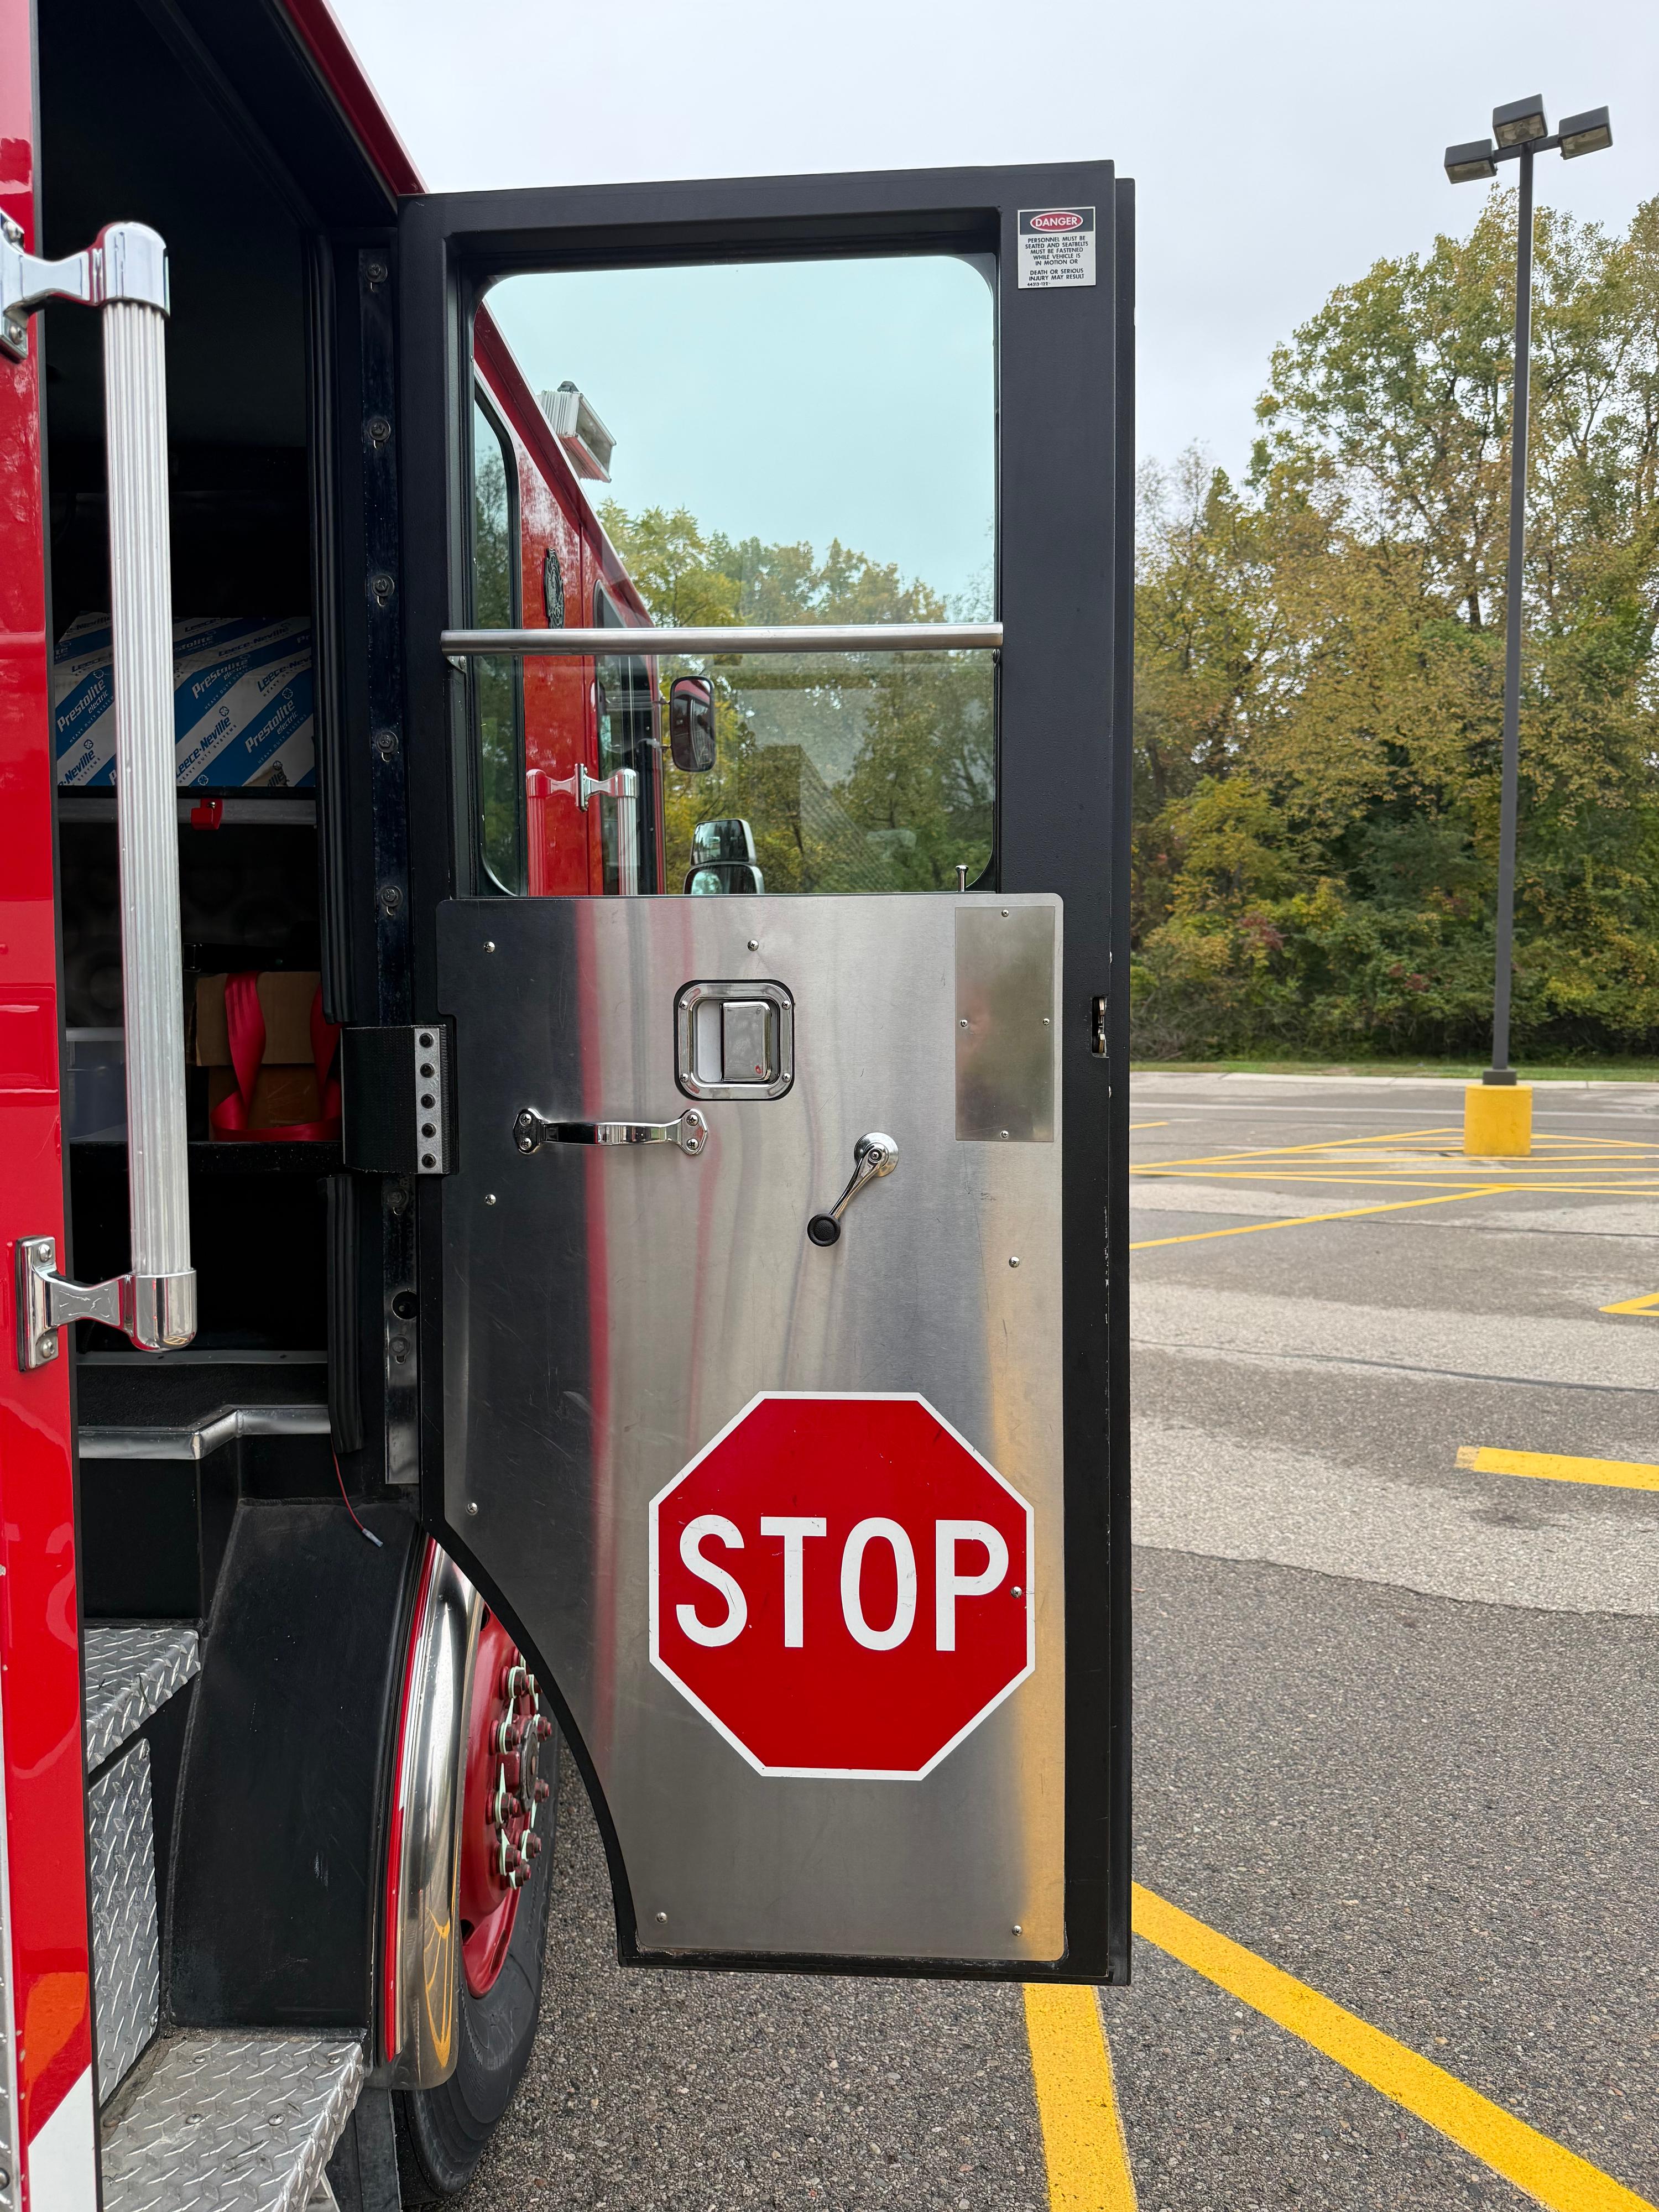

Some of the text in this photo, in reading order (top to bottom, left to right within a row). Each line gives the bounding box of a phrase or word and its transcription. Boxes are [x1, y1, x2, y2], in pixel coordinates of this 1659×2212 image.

[1035, 217, 1078, 227] DANGER
[192, 659, 248, 699] Prestolite
[58, 679, 106, 733] Prestolite
[88, 690, 108, 714] electric
[97, 696, 114, 713] SYSTEM
[205, 681, 232, 709] HEAVY DUTY
[245, 700, 295, 753] Prestolite
[277, 711, 298, 734] electric
[258, 749, 272, 764] HEAVY
[273, 735, 285, 748] DUTY
[179, 767, 195, 783] HEAVY
[198, 751, 211, 764] DUTY
[676, 1514, 1009, 1651] STOP
